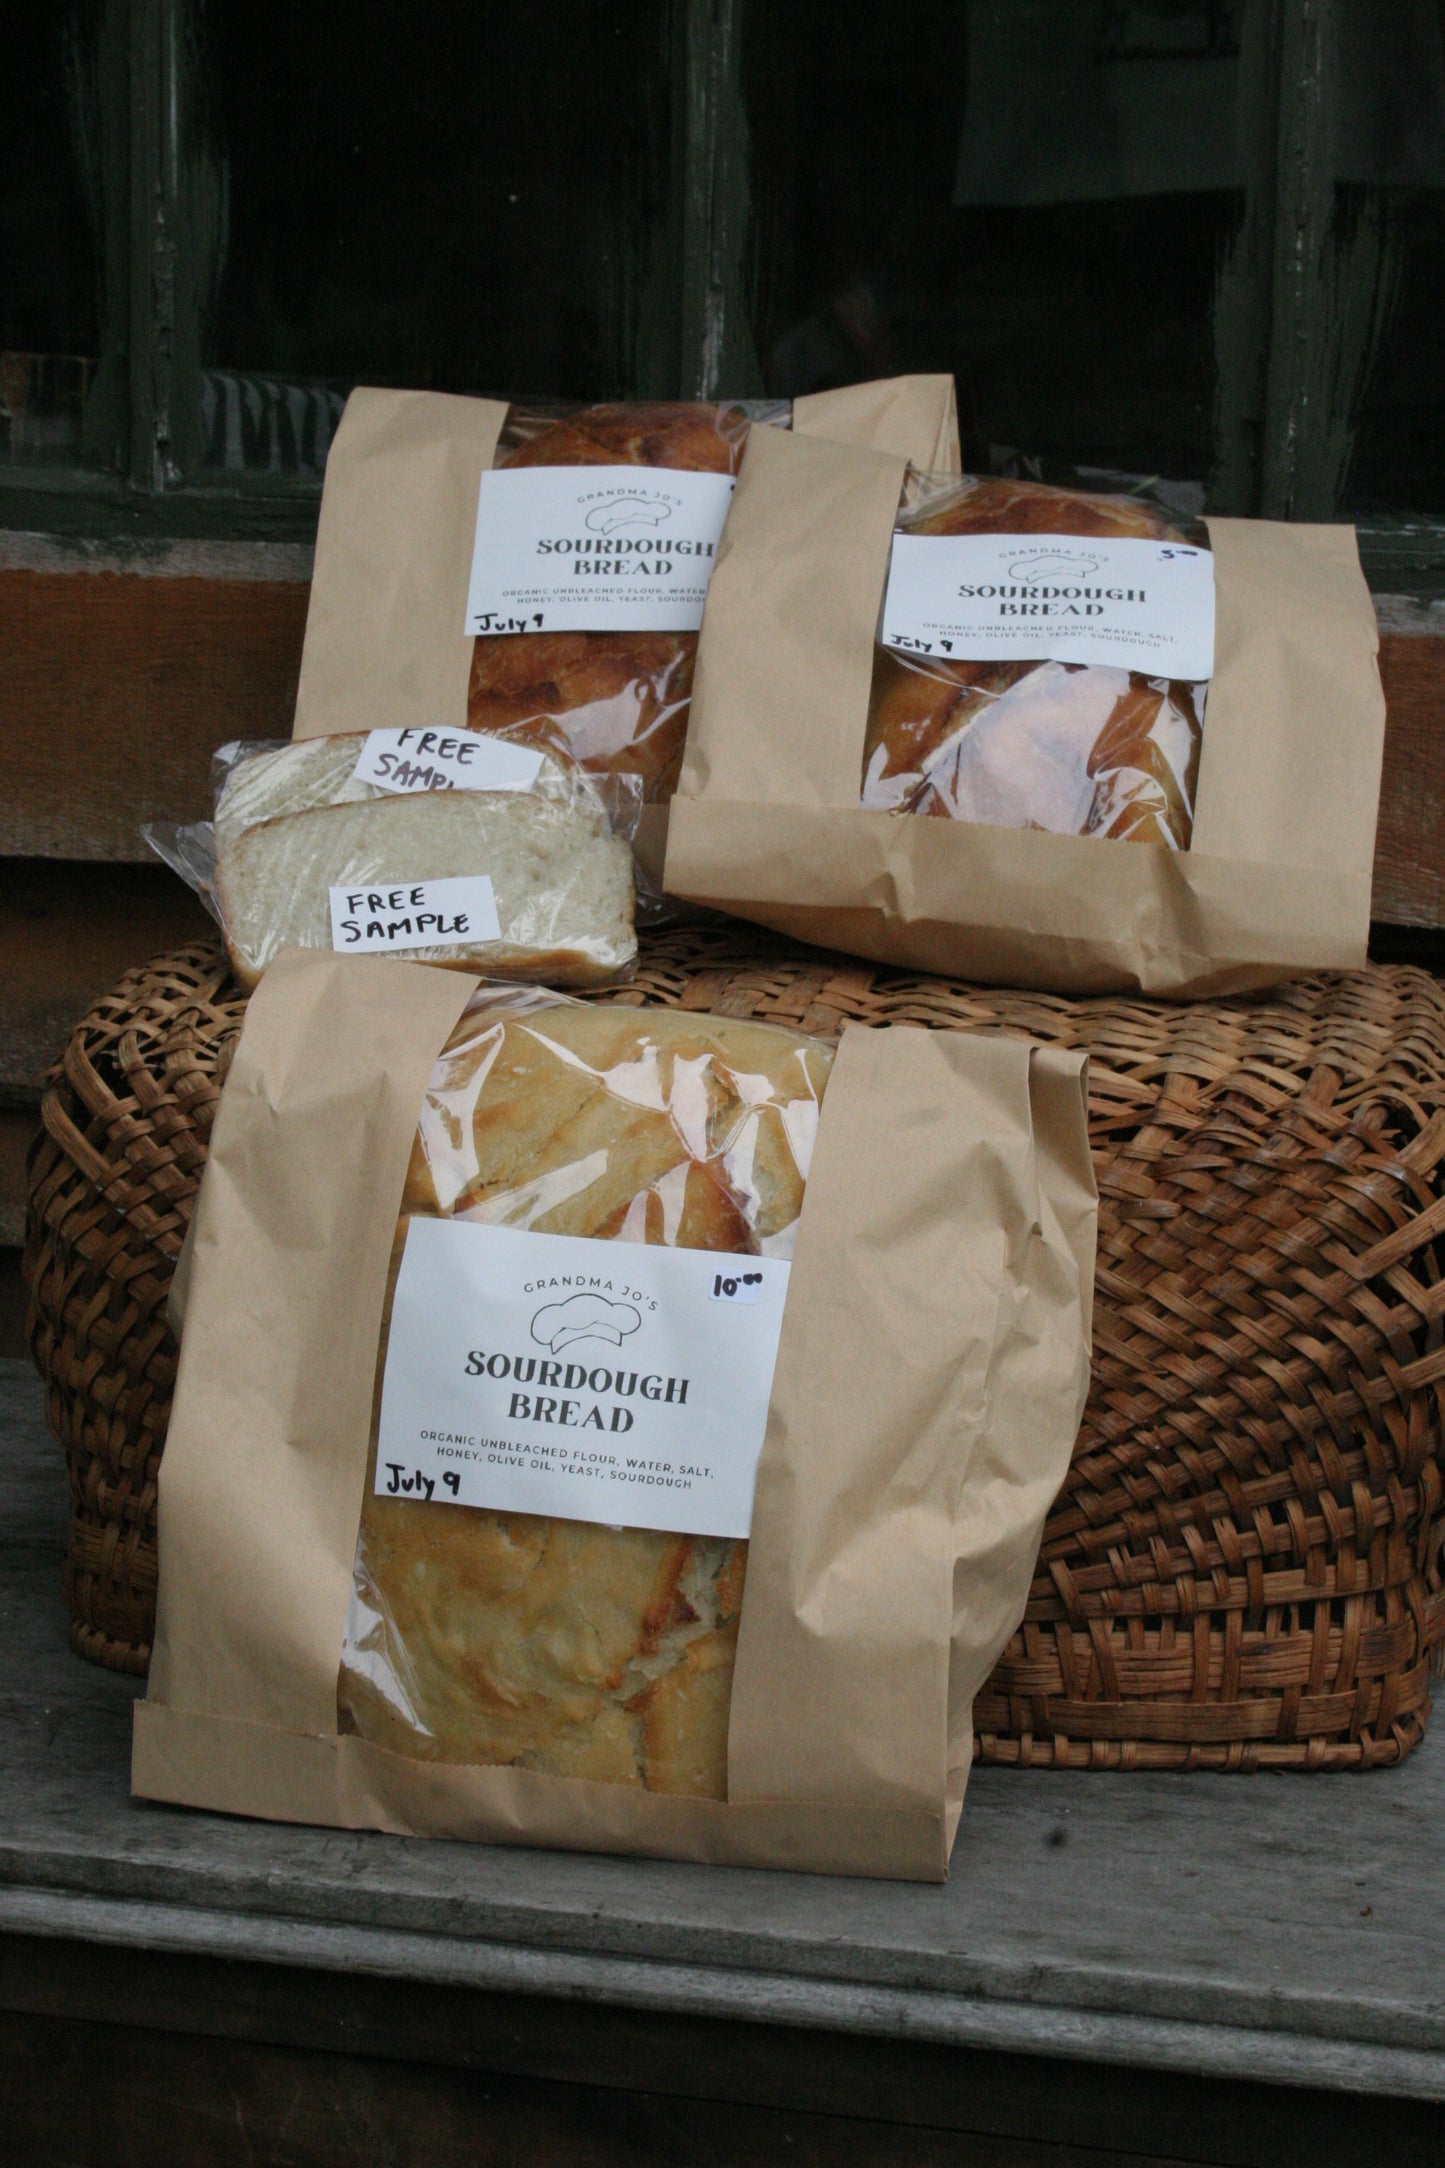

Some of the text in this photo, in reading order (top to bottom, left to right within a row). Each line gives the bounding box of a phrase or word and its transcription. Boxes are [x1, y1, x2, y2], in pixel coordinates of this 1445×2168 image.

[577, 488, 683, 507] GRANDMA JO'S
[536, 539, 714, 557] SOURDOUGH
[998, 547, 1110, 563] GRANDMA JO'S
[573, 560, 673, 576] BREAD
[502, 588, 548, 597] ORGANIC
[516, 596, 555, 604] HONEY,
[958, 585, 1147, 603] SOURDOUGH
[999, 603, 1105, 617] BREAD
[474, 613, 544, 633] July 9
[922, 622, 974, 631] ORGANIC
[977, 623, 1054, 632] UNBLEACHED
[890, 634, 954, 653] July 9
[1091, 632, 1161, 649] SOURDOUGH
[397, 728, 481, 766] FREE
[346, 886, 427, 915] FREE
[340, 913, 470, 942] SAMPLE
[523, 1275, 659, 1312] GRANDMA JO'S
[464, 1350, 690, 1405] SOURDOUGH
[508, 1393, 635, 1434] BREAD
[419, 1430, 715, 1480] ORGANIC UNBLEACHED FLOUR, WATER, SALT,
[436, 1447, 693, 1489] HONEY, OLIVE OIL, YEAST, SOURDOUGH
[385, 1462, 461, 1501] July 9
